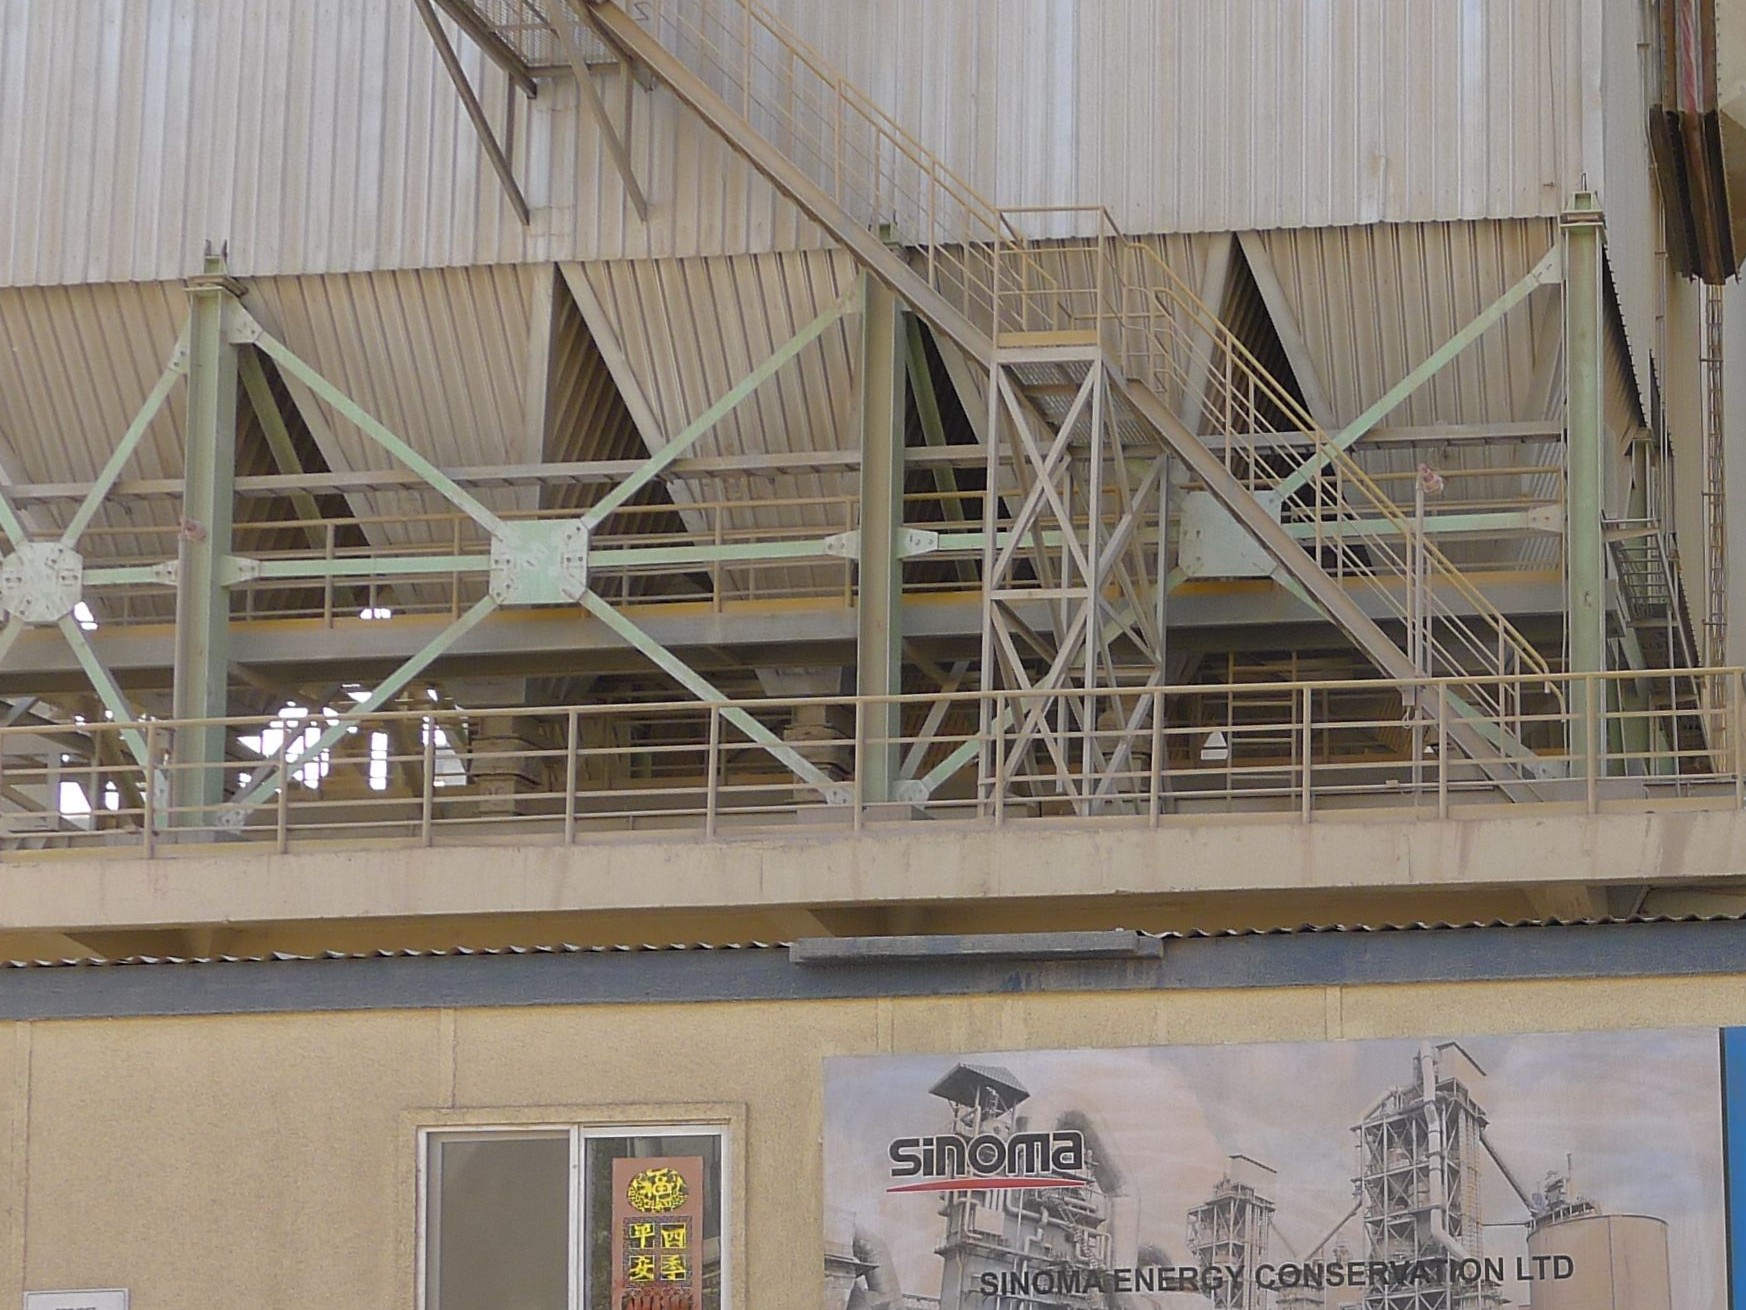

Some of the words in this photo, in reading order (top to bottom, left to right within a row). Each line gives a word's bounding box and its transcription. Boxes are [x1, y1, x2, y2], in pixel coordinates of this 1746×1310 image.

[980, 1267, 1106, 1297] SINOMA
[1114, 1264, 1247, 1294] ENERGY
[1255, 1256, 1504, 1289] CONSERVATION
[1517, 1254, 1575, 1282] LTD
